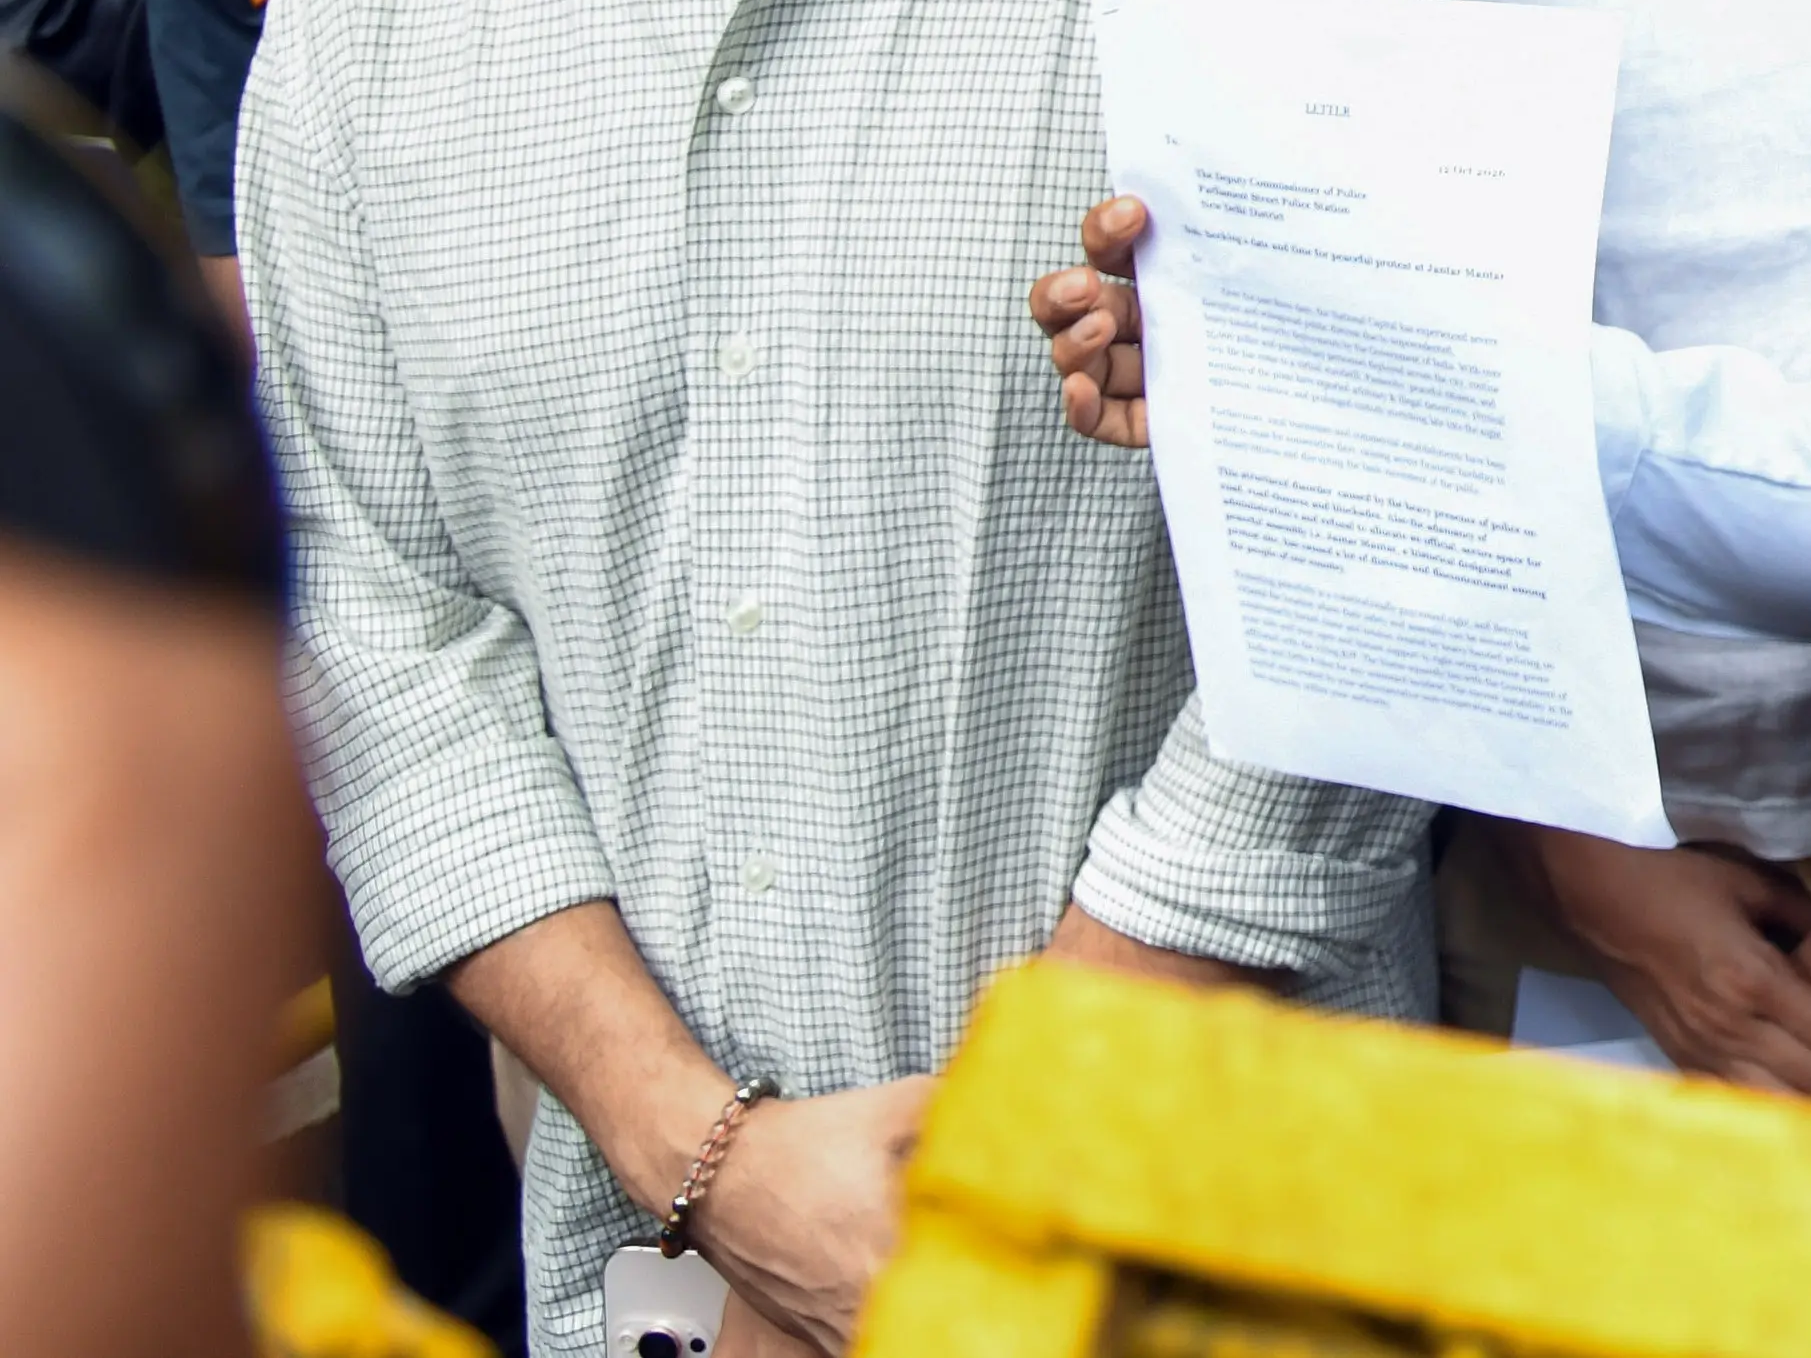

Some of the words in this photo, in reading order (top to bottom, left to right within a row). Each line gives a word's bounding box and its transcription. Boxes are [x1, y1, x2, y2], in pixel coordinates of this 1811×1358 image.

[1198, 183, 1249, 200] Parliament
[1282, 195, 1310, 209] Police
[1215, 171, 1246, 187] Deputy
[1249, 175, 1319, 195] Commissioner
[1322, 185, 1333, 196] of
[1335, 187, 1366, 201] Police
